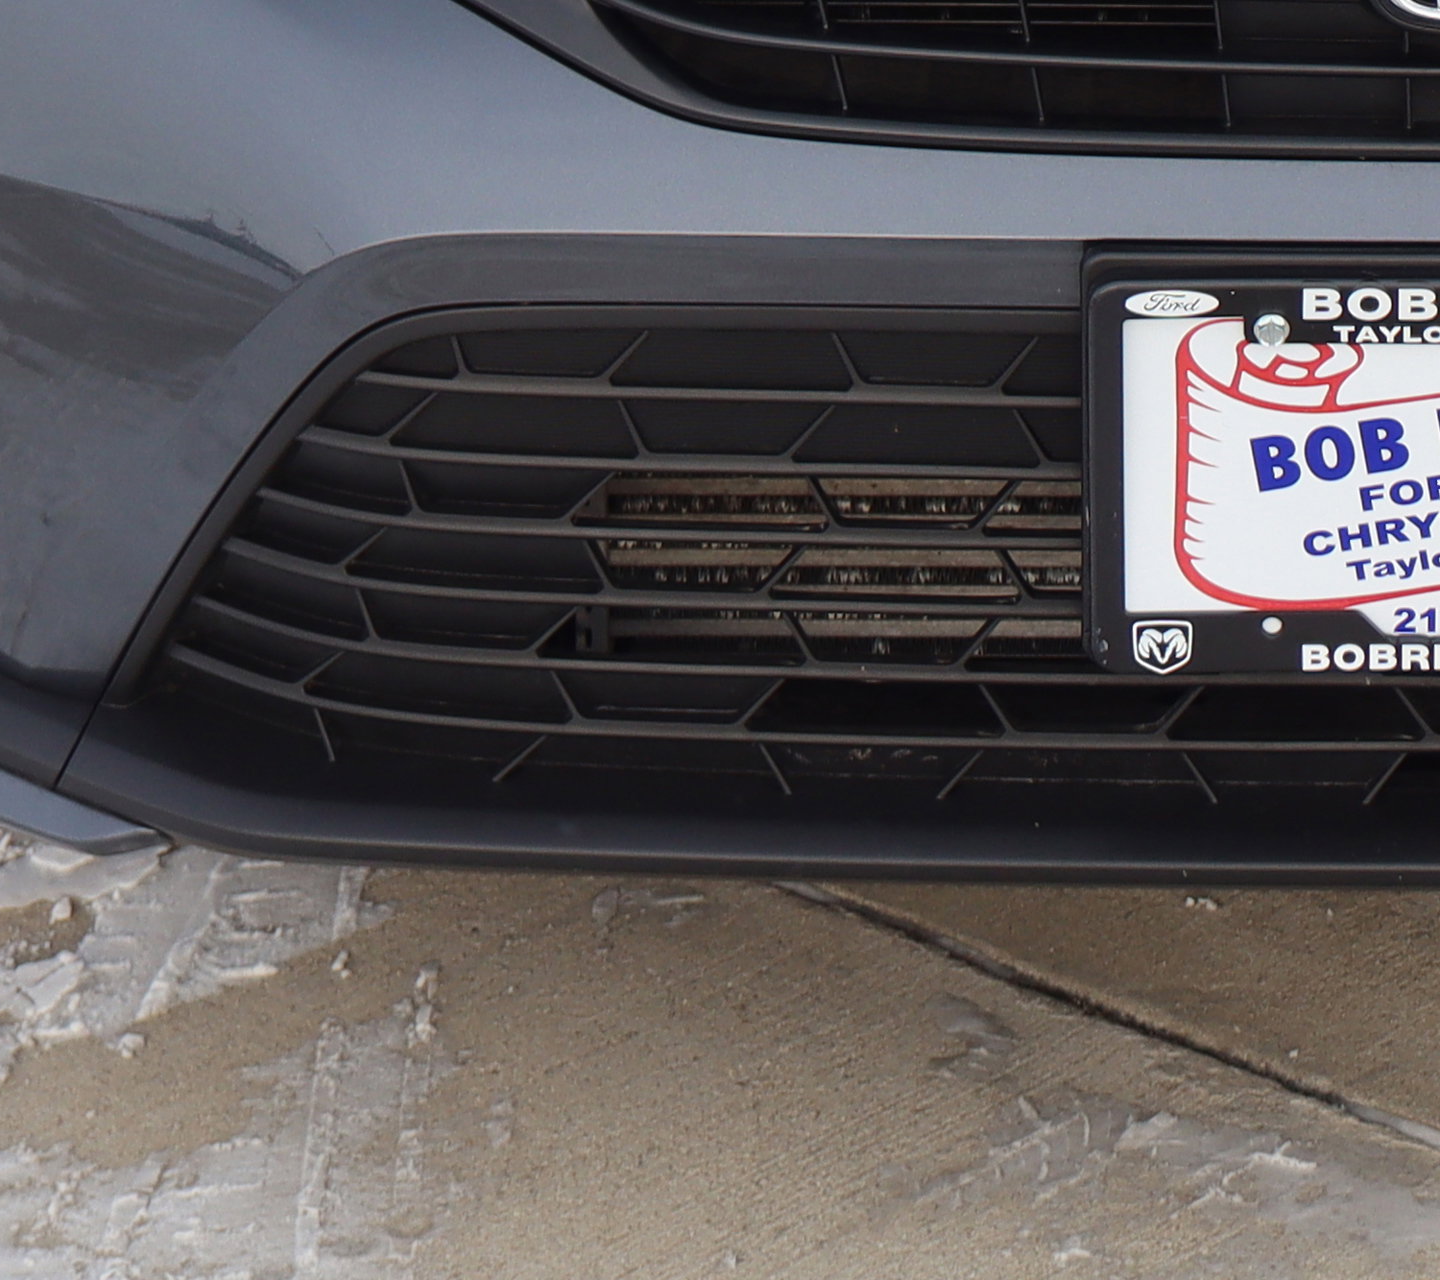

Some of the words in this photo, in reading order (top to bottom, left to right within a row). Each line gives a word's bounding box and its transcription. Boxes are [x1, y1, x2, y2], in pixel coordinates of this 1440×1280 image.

[1143, 292, 1201, 312] Ford
[1302, 287, 1438, 321] BOB
[1250, 418, 1410, 492] BOB
